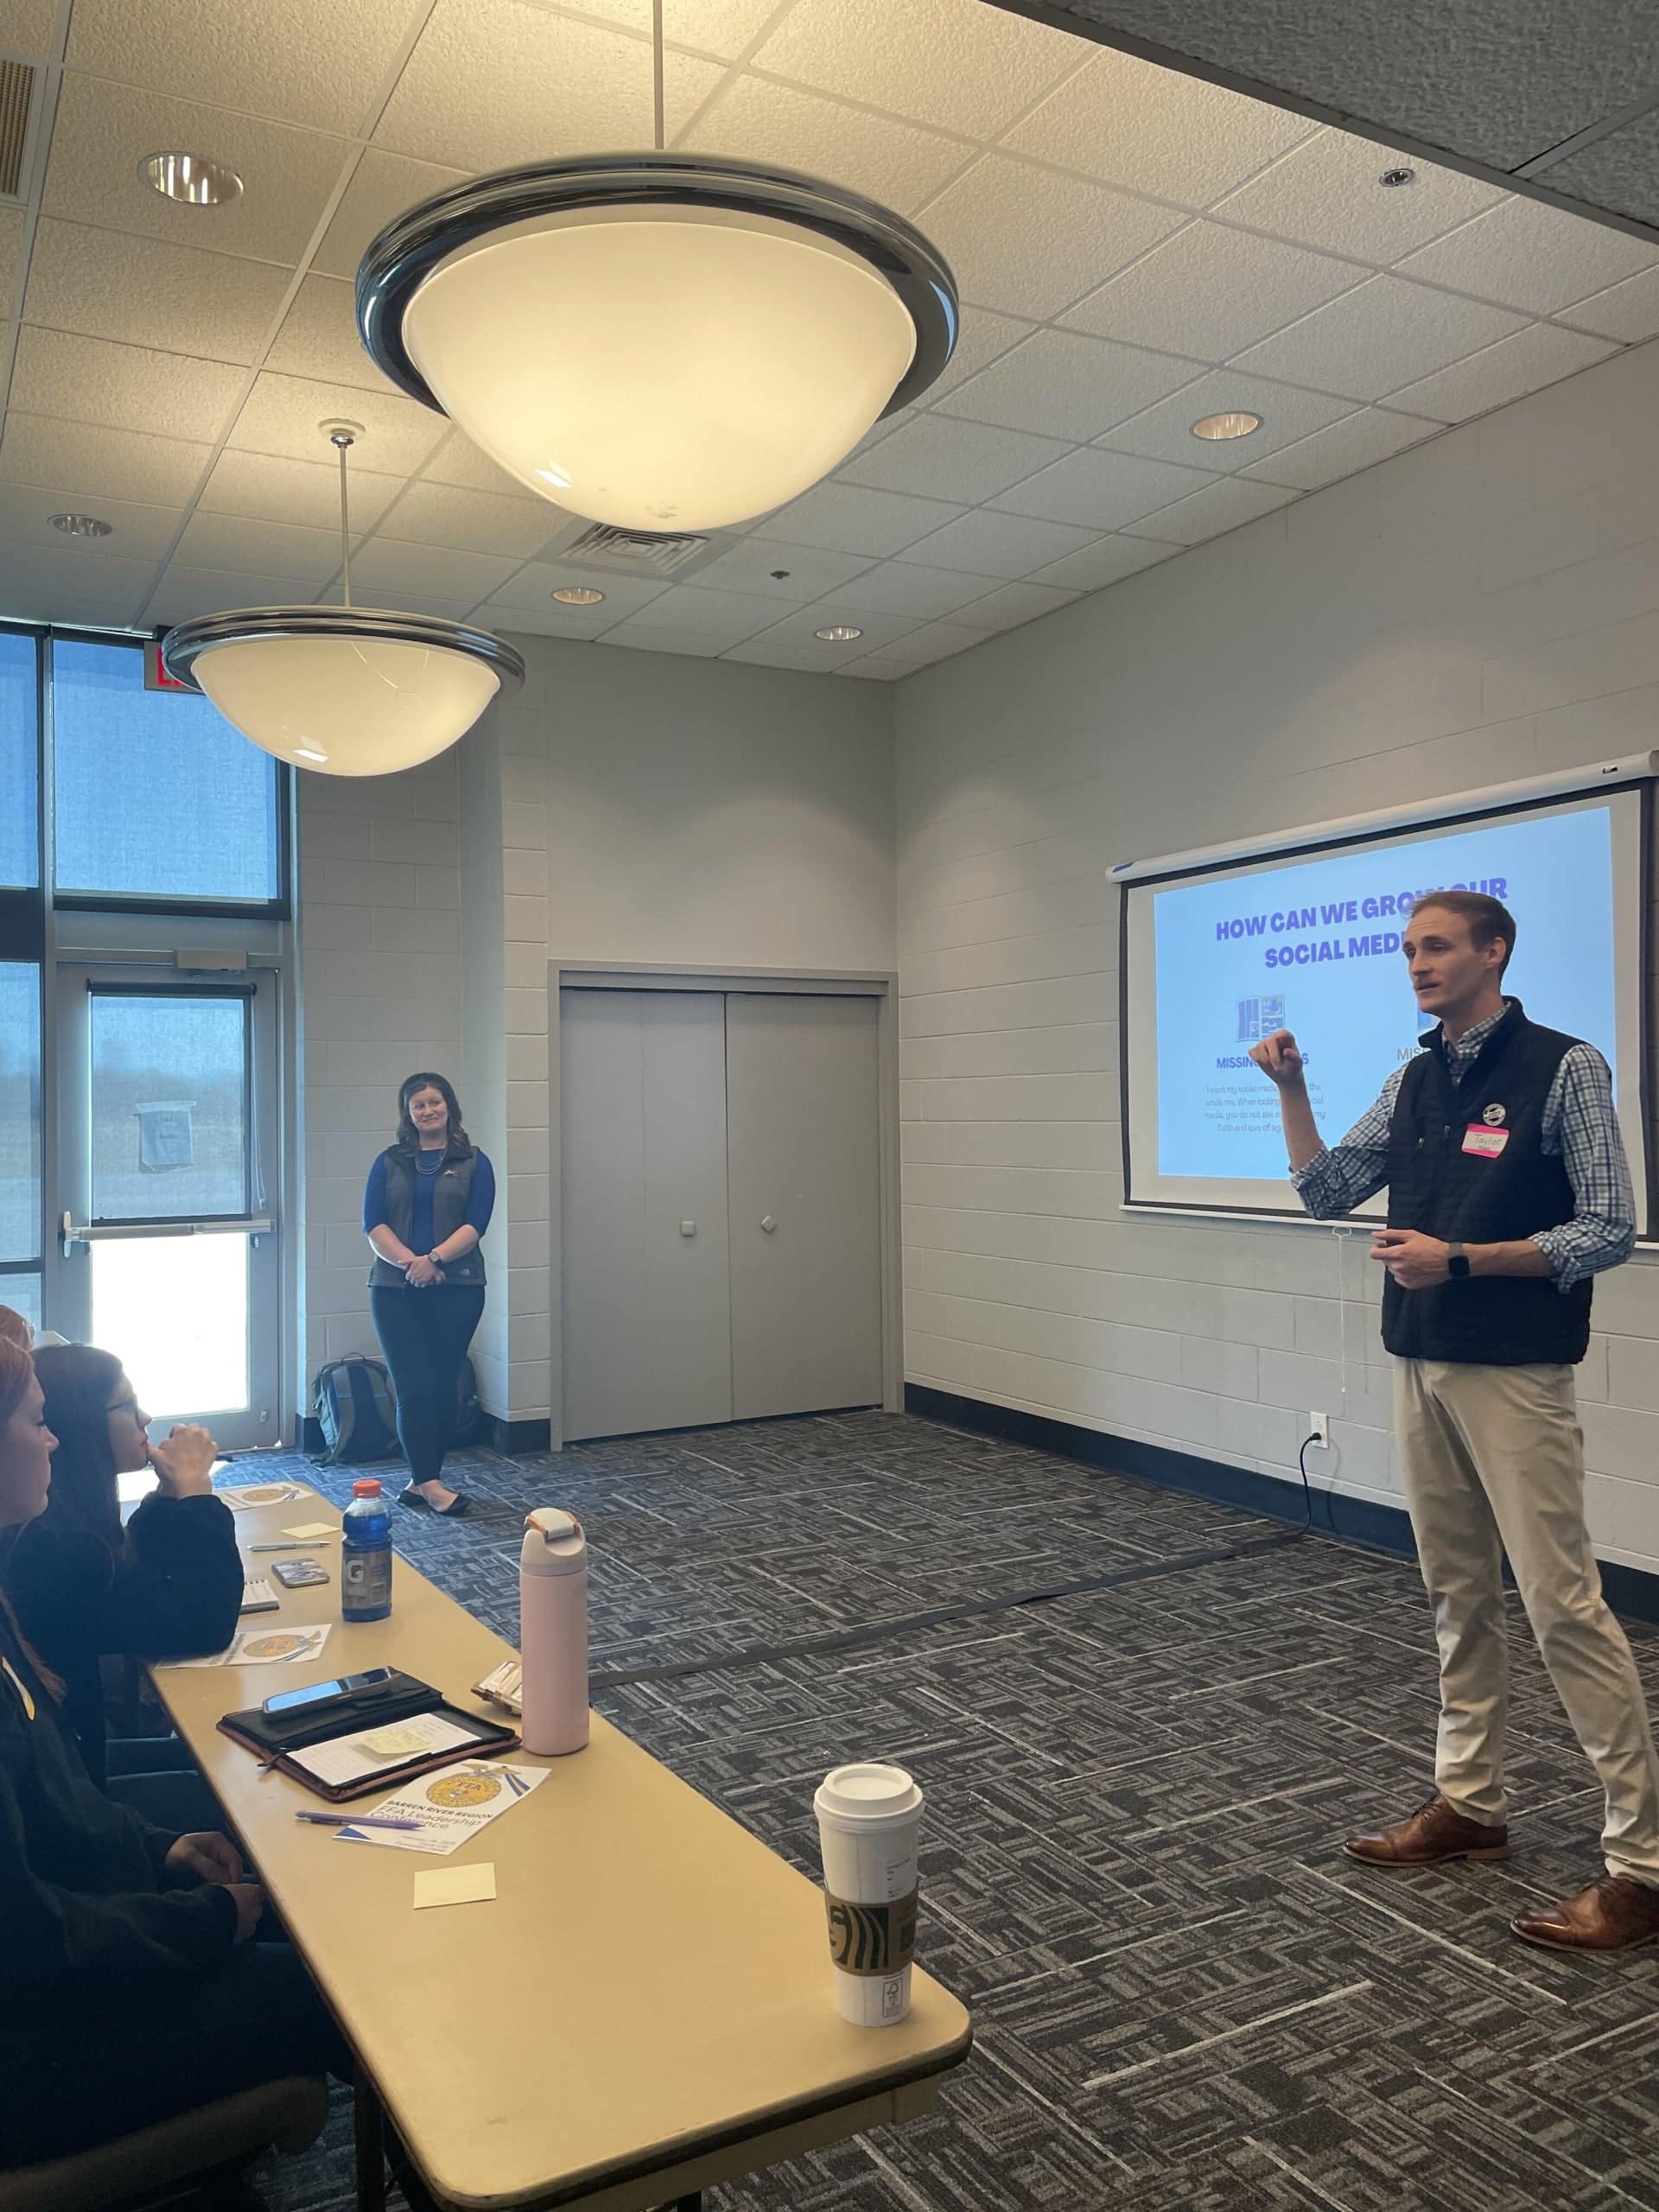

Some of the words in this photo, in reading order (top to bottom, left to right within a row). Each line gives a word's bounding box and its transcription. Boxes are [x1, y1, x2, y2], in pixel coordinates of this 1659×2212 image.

[1217, 915, 1267, 941] HOW
[1270, 907, 1316, 932] CAN
[1320, 900, 1357, 925] WE
[1362, 887, 1444, 918] GRO
[1265, 940, 1344, 968] SOCIAL
[1349, 931, 1405, 957] MED
[378, 1805, 405, 1815] FFA
[408, 1810, 481, 1827] Leadership
[386, 1800, 424, 1810] BARREN
[427, 1807, 454, 1815] RIVER
